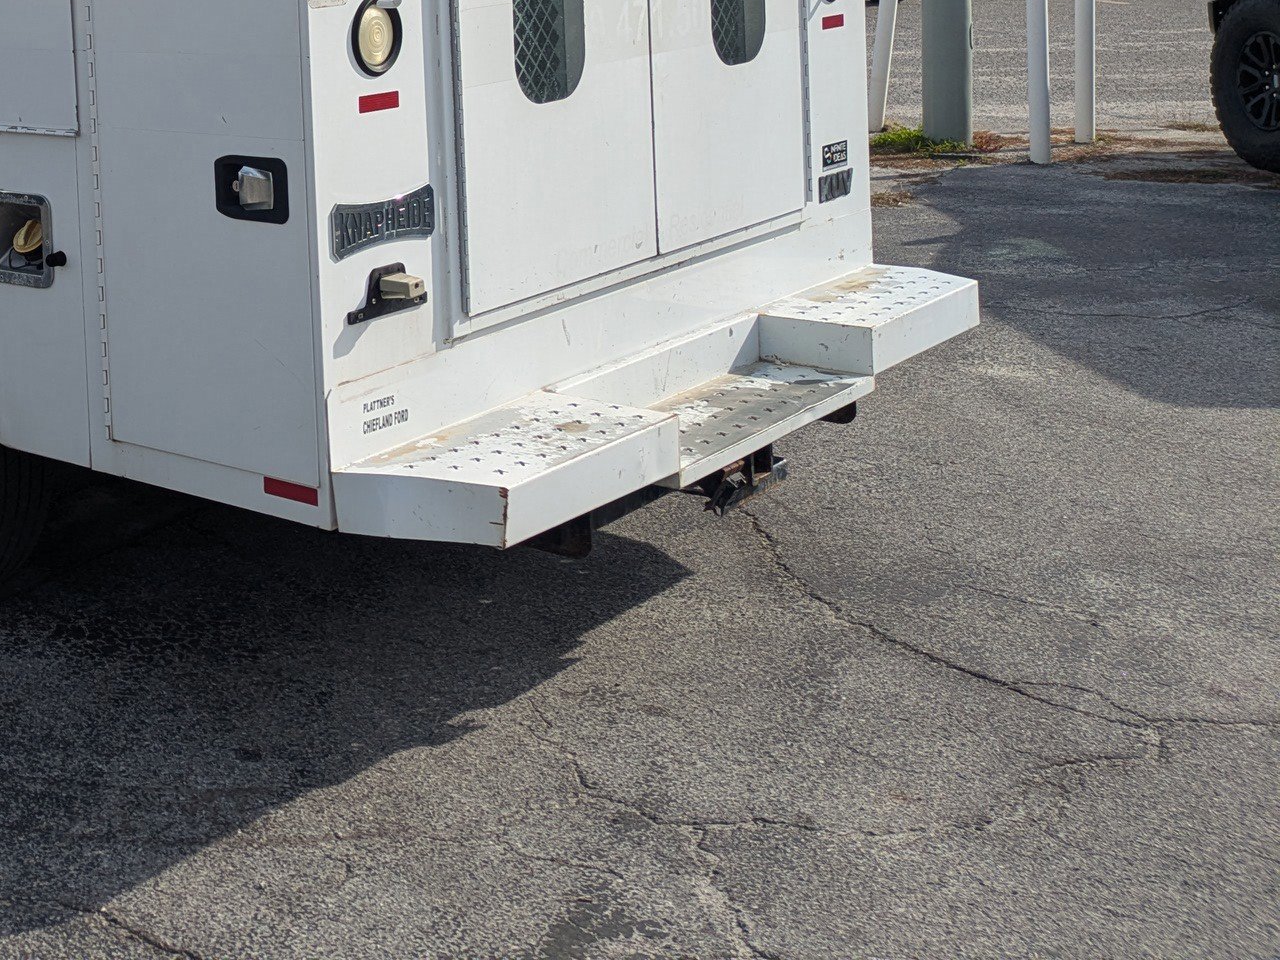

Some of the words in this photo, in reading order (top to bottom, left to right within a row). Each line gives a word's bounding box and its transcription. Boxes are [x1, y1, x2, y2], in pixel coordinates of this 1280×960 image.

[818, 167, 853, 204] KUV
[337, 196, 432, 252] KNAPHEIDE
[363, 395, 395, 413] PLATTNER'S
[363, 413, 393, 434] CHIEFLAND
[394, 408, 409, 425] FORD
